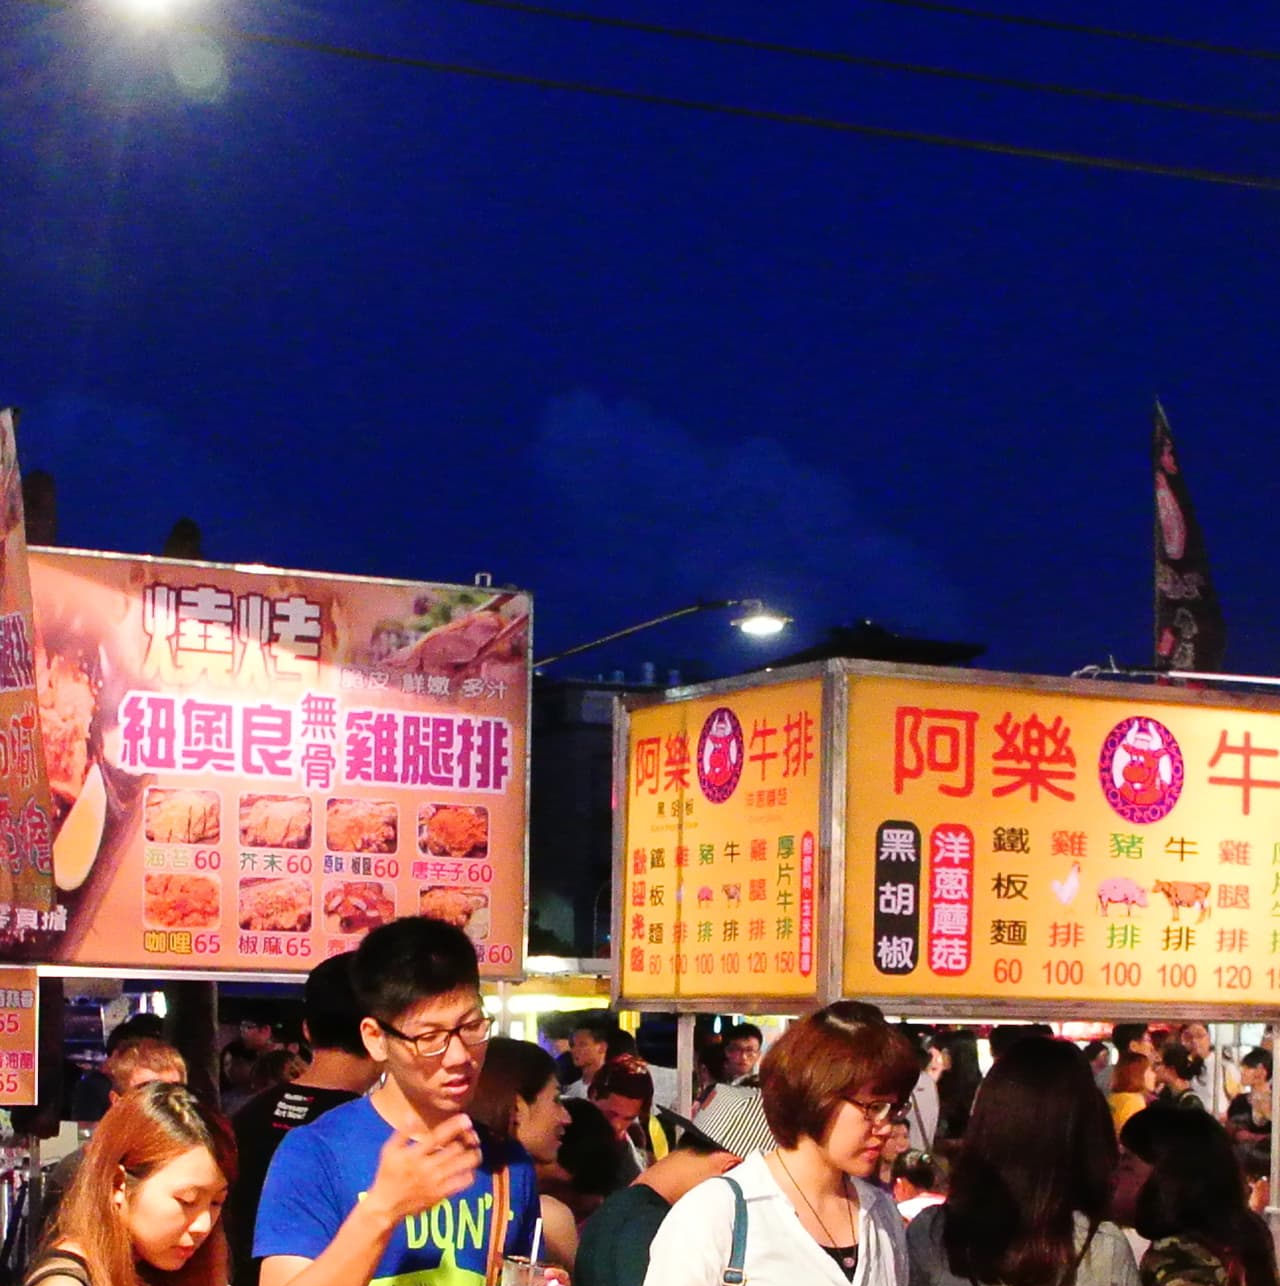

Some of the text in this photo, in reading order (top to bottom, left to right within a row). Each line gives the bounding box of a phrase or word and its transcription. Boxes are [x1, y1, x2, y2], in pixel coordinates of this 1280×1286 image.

[141, 580, 322, 690] 燒烤
[461, 677, 508, 700] 多汁
[121, 691, 509, 791] 紐奧良 無骨 雞腿排
[635, 710, 815, 798] 阿樂 牛排
[894, 704, 1078, 803] 阿樂
[194, 849, 221, 870] 60
[239, 852, 313, 874] 芥末 60
[374, 859, 400, 879] 60
[467, 864, 493, 883] 60
[877, 828, 918, 970] 黑胡椒
[931, 830, 972, 972] 洋蔥蘑菇
[989, 826, 1031, 985] 鐵板麵 60
[1041, 829, 1089, 986] 雞排 100
[1100, 832, 1145, 988] 豬排 100
[1156, 836, 1199, 989] 牛排 100
[1213, 839, 1253, 990] 雞腿排 120
[144, 929, 220, 954] 咖哩 65
[286, 938, 312, 957] 65
[488, 945, 513, 964] 60
[695, 952, 715, 976] 100
[720, 952, 741, 975] 100
[774, 950, 796, 974] 150
